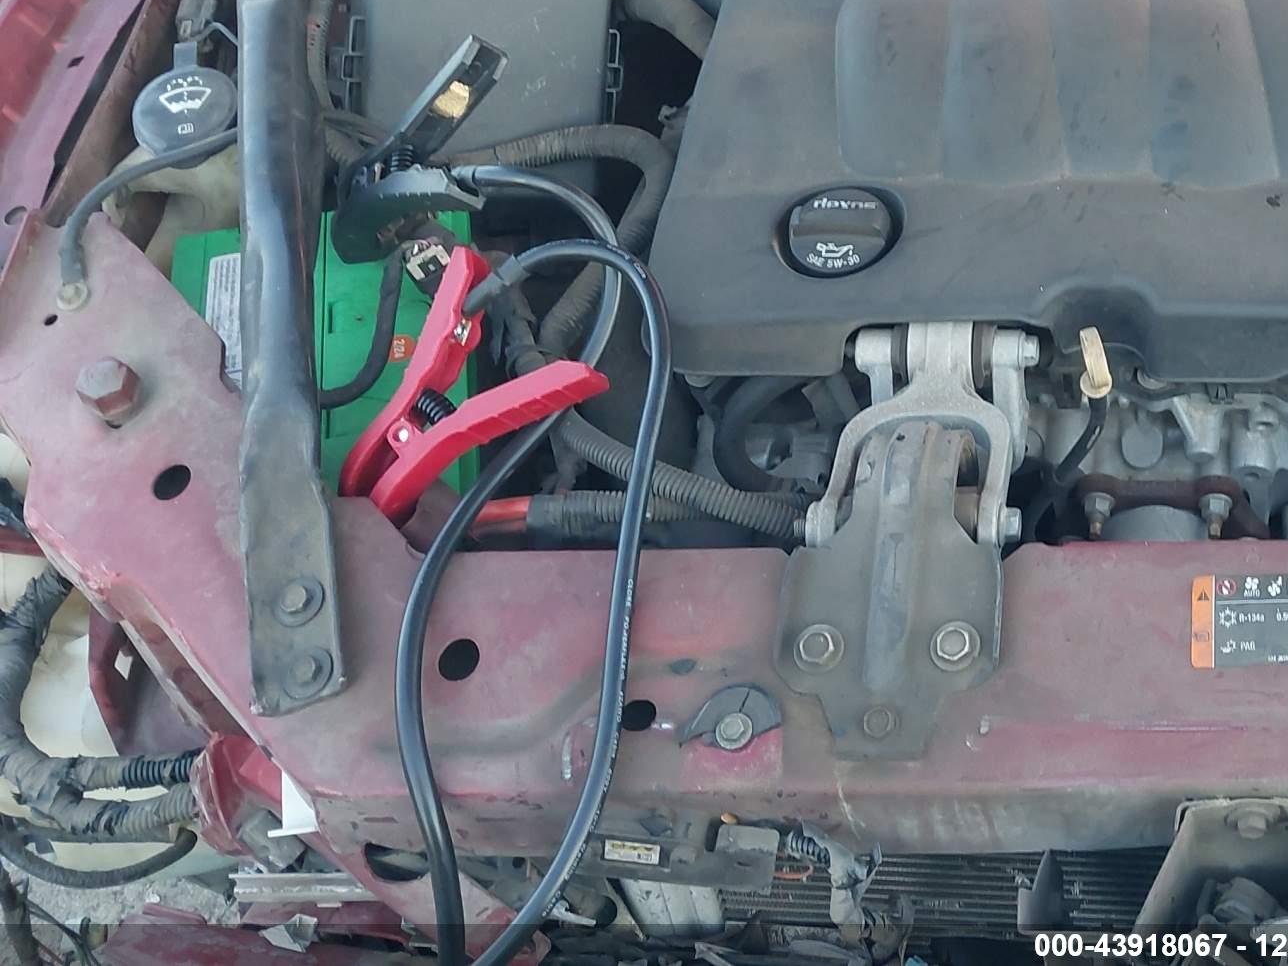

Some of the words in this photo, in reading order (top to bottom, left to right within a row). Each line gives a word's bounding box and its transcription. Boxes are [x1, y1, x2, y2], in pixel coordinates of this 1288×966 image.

[806, 252, 826, 268] SAE
[826, 253, 861, 269] 5W-30
[1244, 589, 1261, 598] AUTO
[1239, 612, 1265, 623] R-134a
